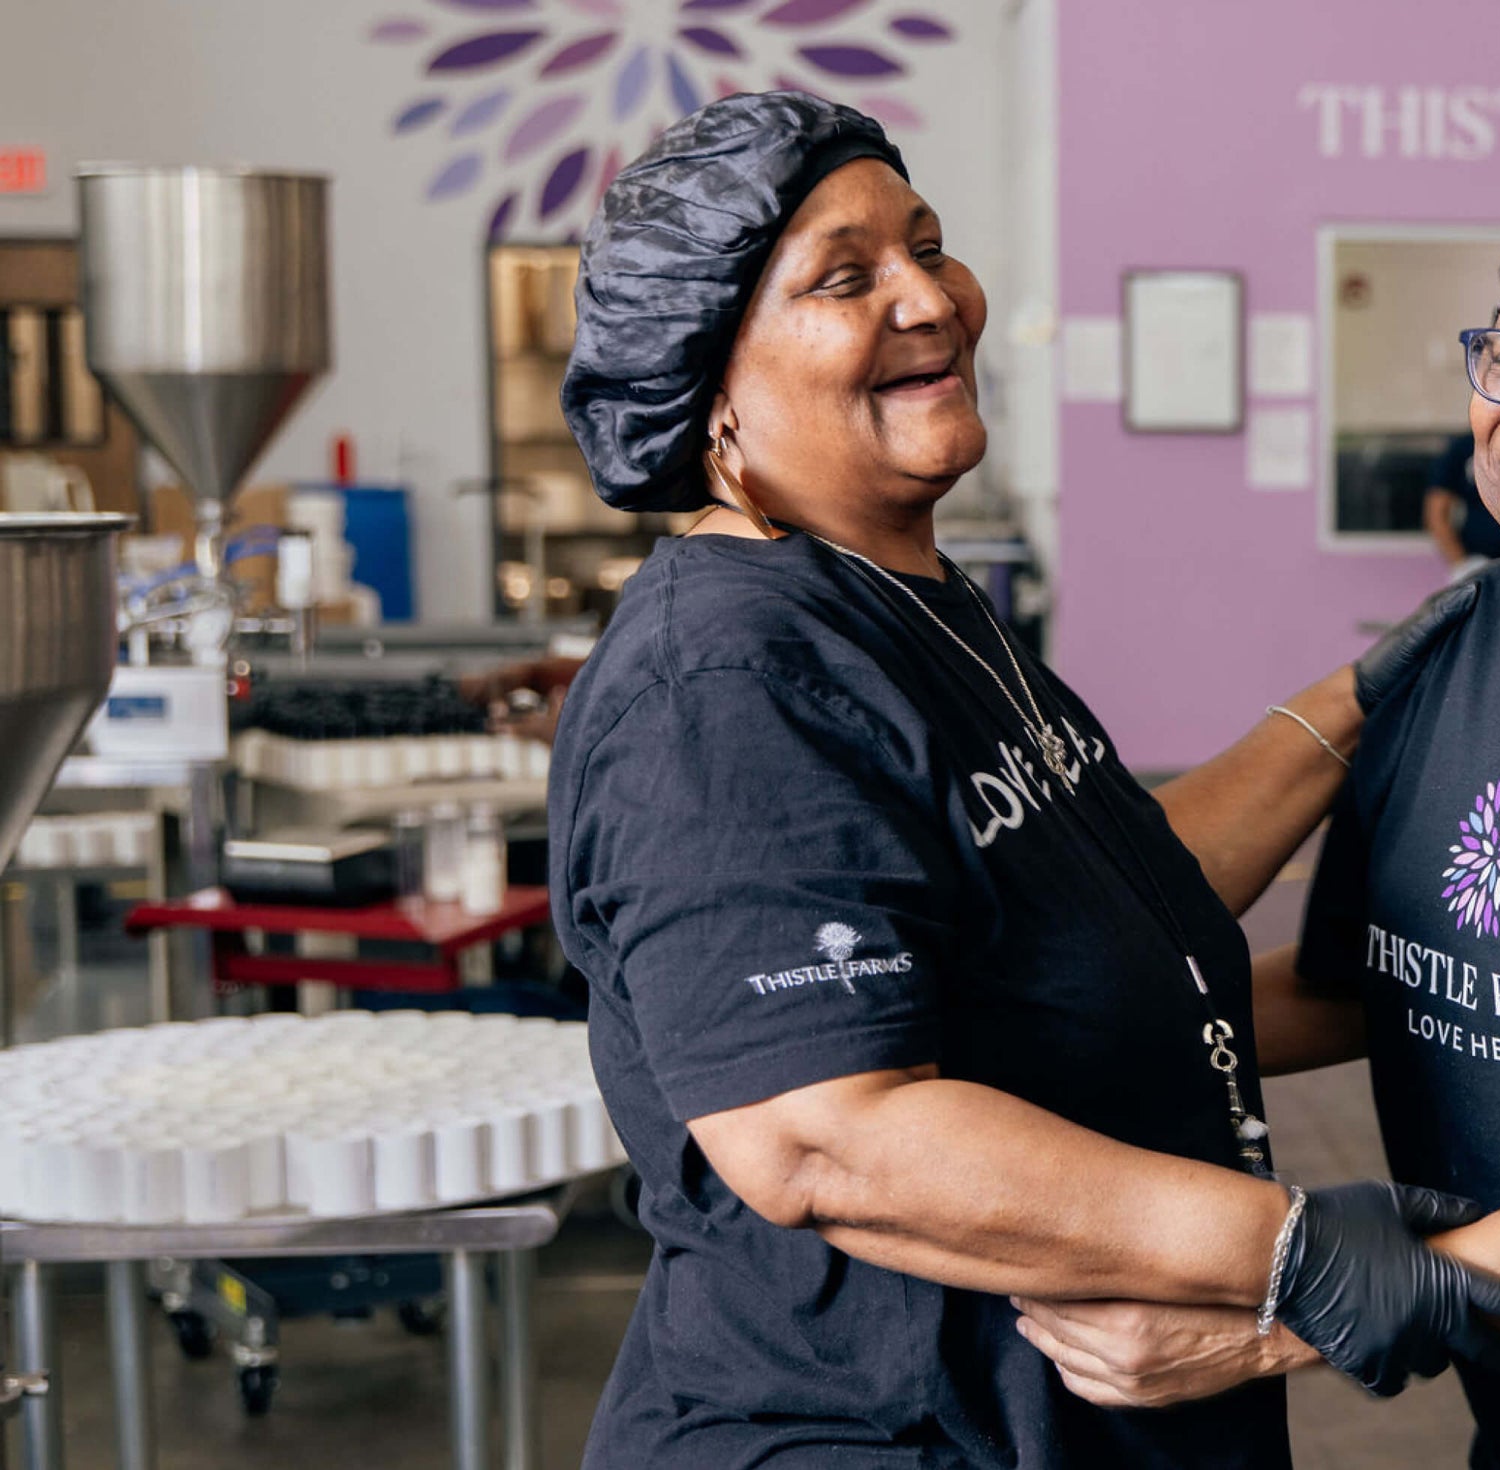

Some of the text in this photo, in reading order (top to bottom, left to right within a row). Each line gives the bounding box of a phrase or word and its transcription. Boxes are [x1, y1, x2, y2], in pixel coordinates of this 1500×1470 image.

[745, 951, 914, 996] THISTLE FARMS
[1367, 923, 1478, 1011] THISTLE
[1408, 1008, 1463, 1051] LOVE
